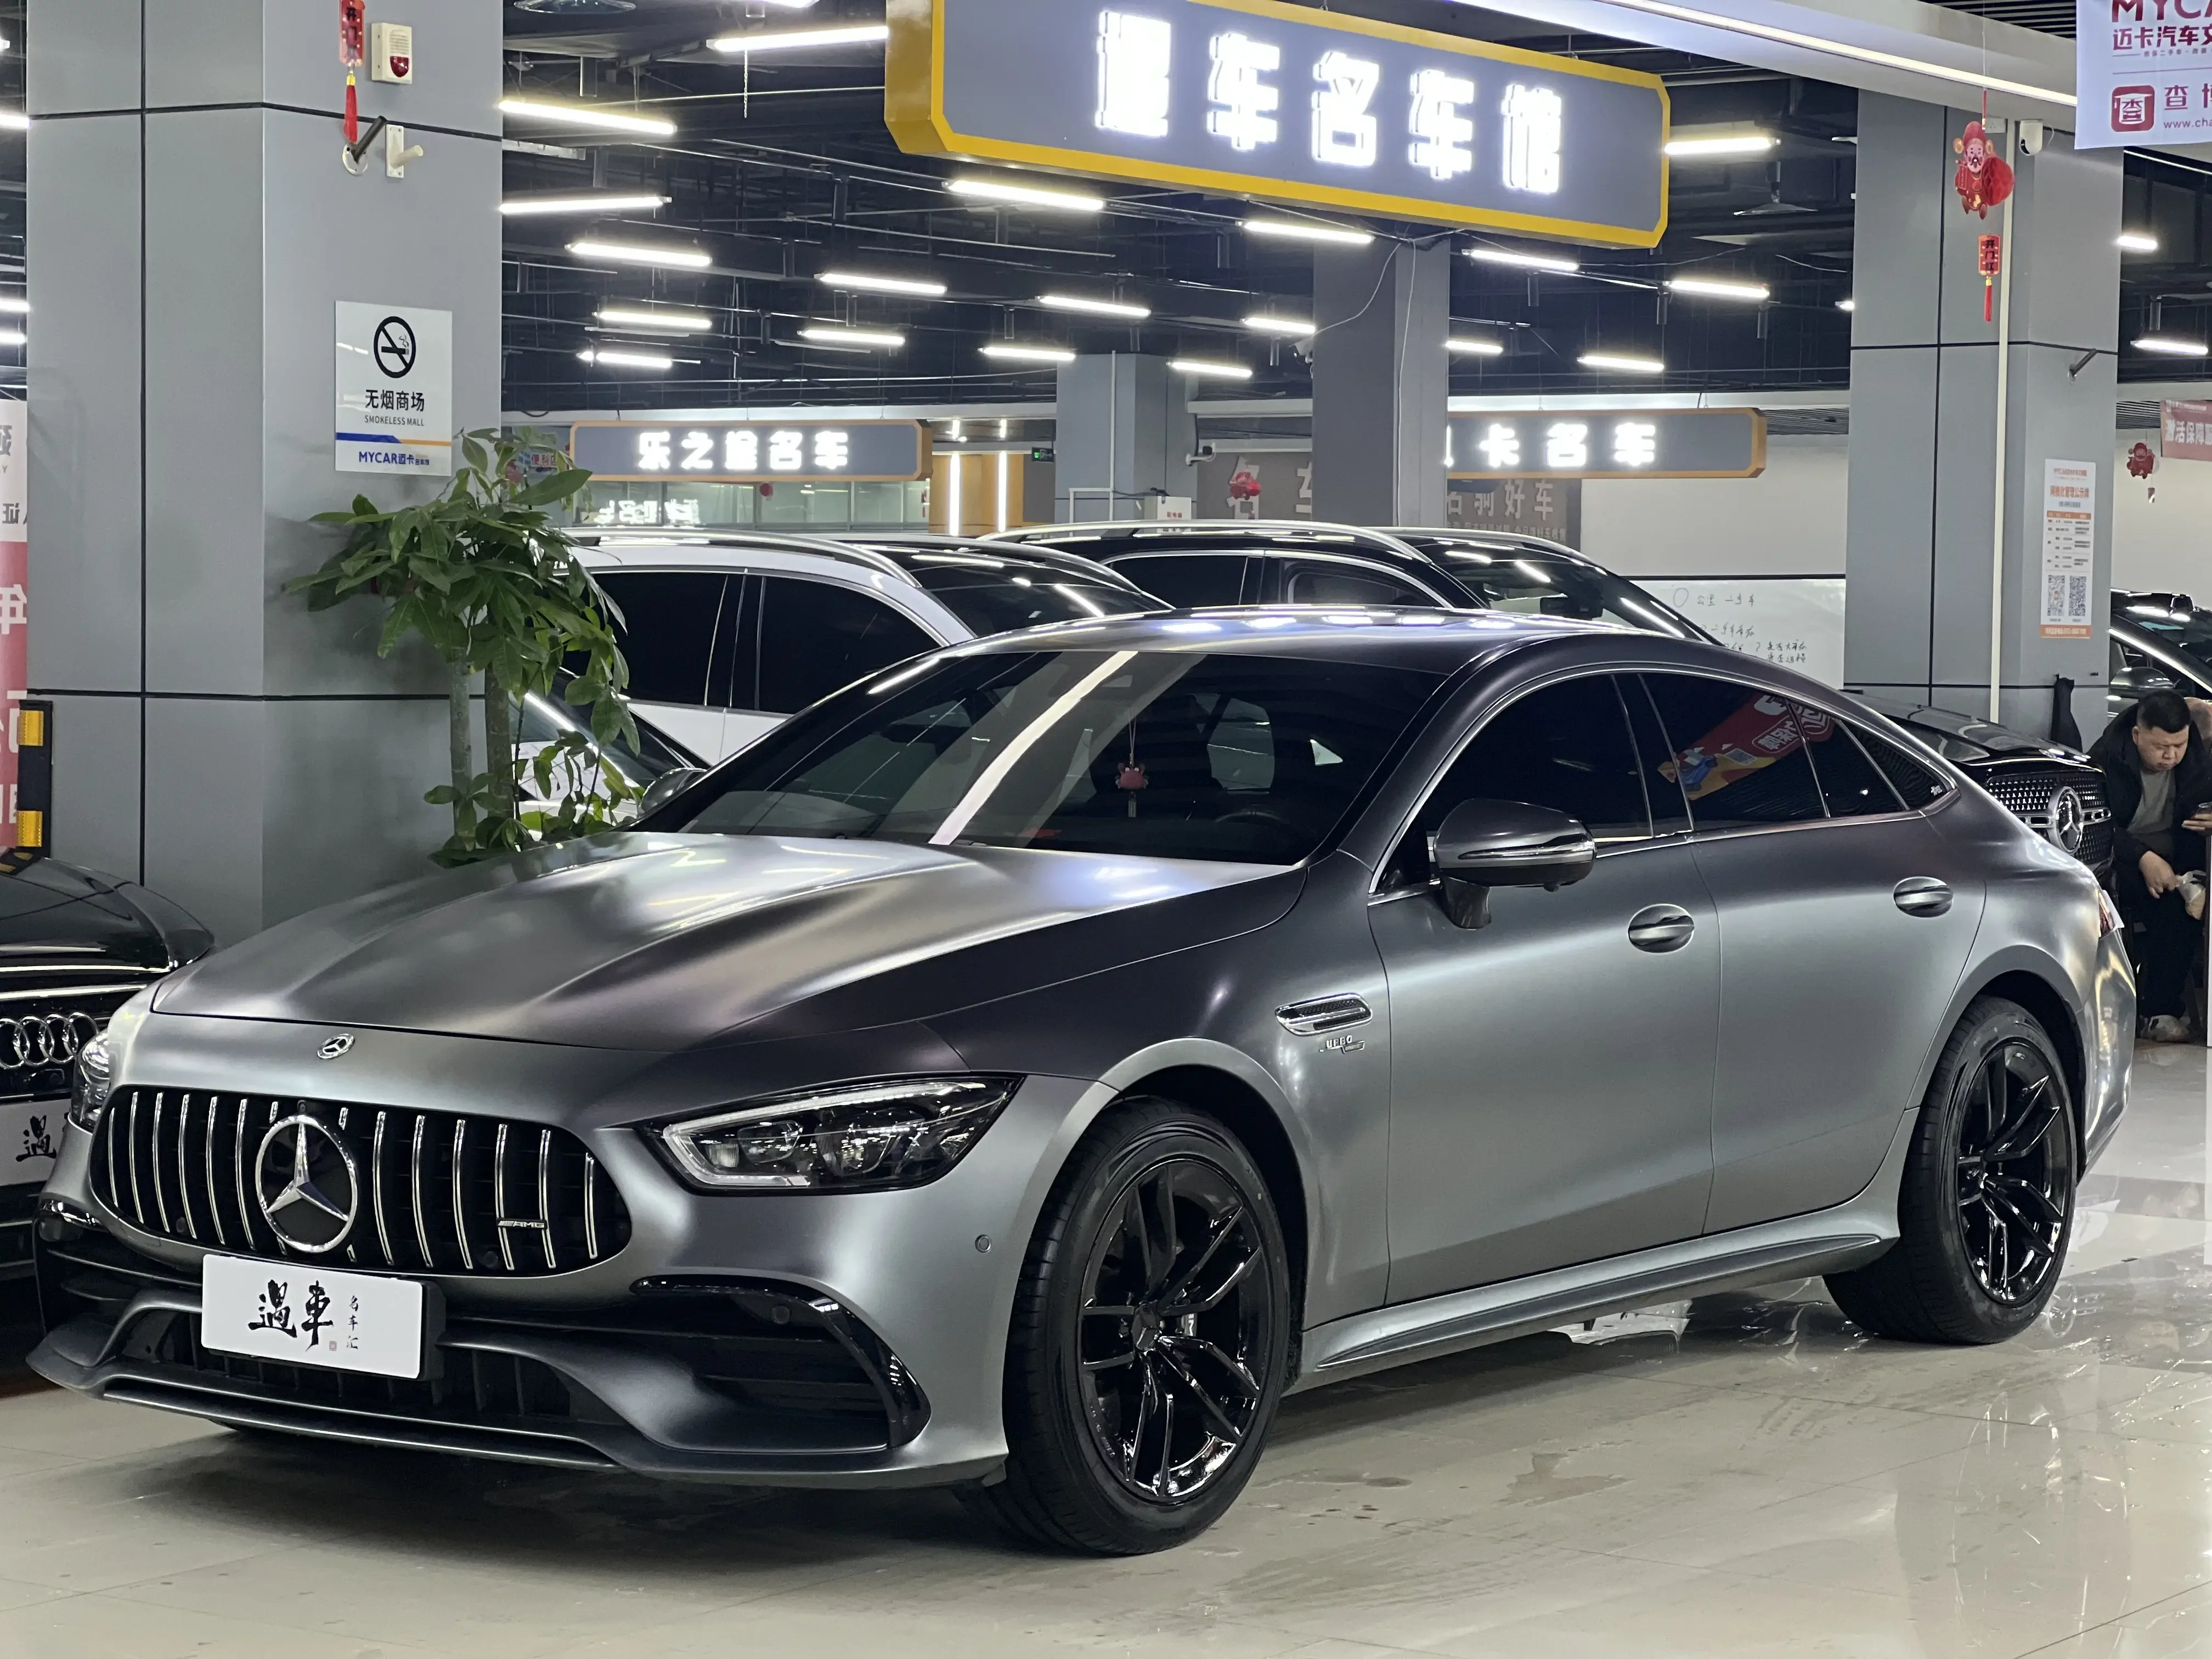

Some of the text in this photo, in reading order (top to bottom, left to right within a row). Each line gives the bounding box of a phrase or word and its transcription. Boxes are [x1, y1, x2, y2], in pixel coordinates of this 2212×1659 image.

[365, 389, 425, 411] 无烟商场
[364, 415, 425, 426] SMOKELESS MALL
[1445, 422, 1656, 468] 卡名车
